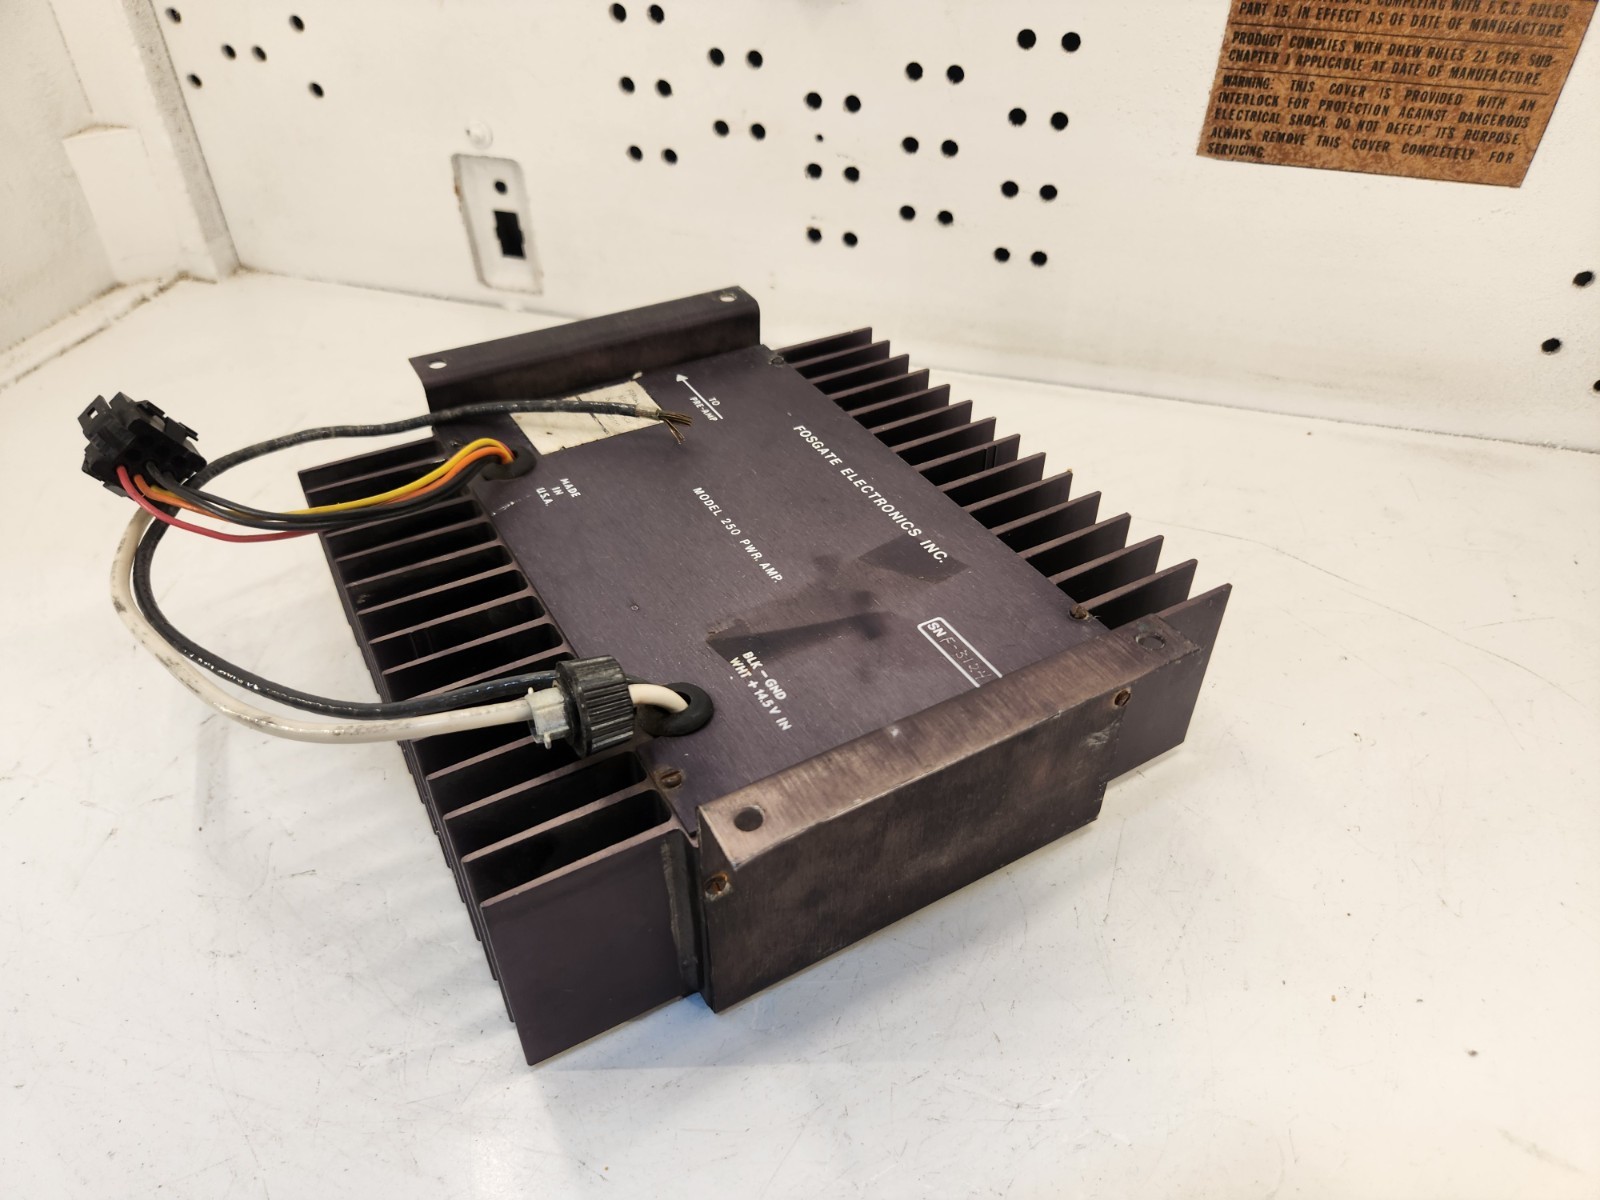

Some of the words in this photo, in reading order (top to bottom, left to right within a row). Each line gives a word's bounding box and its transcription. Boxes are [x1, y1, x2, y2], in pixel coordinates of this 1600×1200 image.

[1239, 2, 1268, 16] PART
[1297, 6, 1310, 20] IN
[1316, 7, 1361, 22] EFFECT
[1368, 12, 1384, 25] AS
[1390, 12, 1406, 26] OF
[1410, 14, 1442, 28] DATE
[1448, 17, 1464, 30] OF
[1450, 0, 1480, 12] WITH
[1527, 3, 1570, 18] RULES
[1232, 32, 1282, 47] PRODUCT
[1289, 35, 1346, 52] COMPLIES
[1354, 40, 1383, 55] WITH
[1427, 46, 1466, 61] RULES
[1473, 50, 1489, 64] 21
[1496, 52, 1520, 66] CFR
[1228, 50, 1278, 64] CHAPTER
[1284, 54, 1290, 66] J
[1296, 54, 1364, 72] APPLICABLE
[1370, 60, 1386, 74] AT
[1391, 62, 1422, 76] DATE
[1428, 64, 1444, 78] OF
[1448, 66, 1542, 86] MANUFACTURE.
[1222, 75, 1274, 90] WARNING:
[1290, 80, 1316, 93] THIS
[1329, 82, 1367, 98] COVER
[1378, 88, 1392, 100] IS
[1404, 90, 1464, 106] PROVIDED
[1476, 95, 1507, 110] WITH
[1519, 100, 1537, 112] AN
[1214, 108, 1280, 124] ELECTRICAL
[1335, 117, 1350, 130] DO
[1356, 120, 1380, 133] NOT
[1386, 122, 1431, 137] DEFEAT
[1218, 92, 1280, 106] INTERLOCK
[1288, 96, 1310, 110] FOR
[1318, 99, 1390, 116] PROTECTION
[1398, 106, 1448, 122] AGAINST
[1458, 112, 1530, 129] DANGEROUS
[1207, 142, 1266, 158] SERVICING.
[1210, 127, 1252, 140] ALWAYS
[1262, 130, 1307, 146] REMOVE
[1316, 135, 1341, 148] THIS
[1352, 138, 1390, 153] COVER
[1402, 143, 1476, 160] COMPLETELY
[1488, 151, 1514, 164] FOR
[690, 396, 718, 421] PRE-AMP
[708, 397, 720, 406] TO
[552, 486, 564, 496] IN
[560, 478, 581, 498] MADE
[793, 425, 843, 466] FOSGATE
[840, 468, 922, 537] ELECTRONICS
[920, 540, 948, 563] INC.
[692, 487, 722, 516] MODEL
[720, 518, 741, 536] 250
[740, 538, 762, 562] PWR.
[759, 562, 783, 583] AMP.
[926, 622, 947, 638] SN
[742, 651, 763, 670] BLK
[764, 678, 787, 700] GND
[730, 656, 752, 678] WHT
[776, 717, 792, 730] IN
